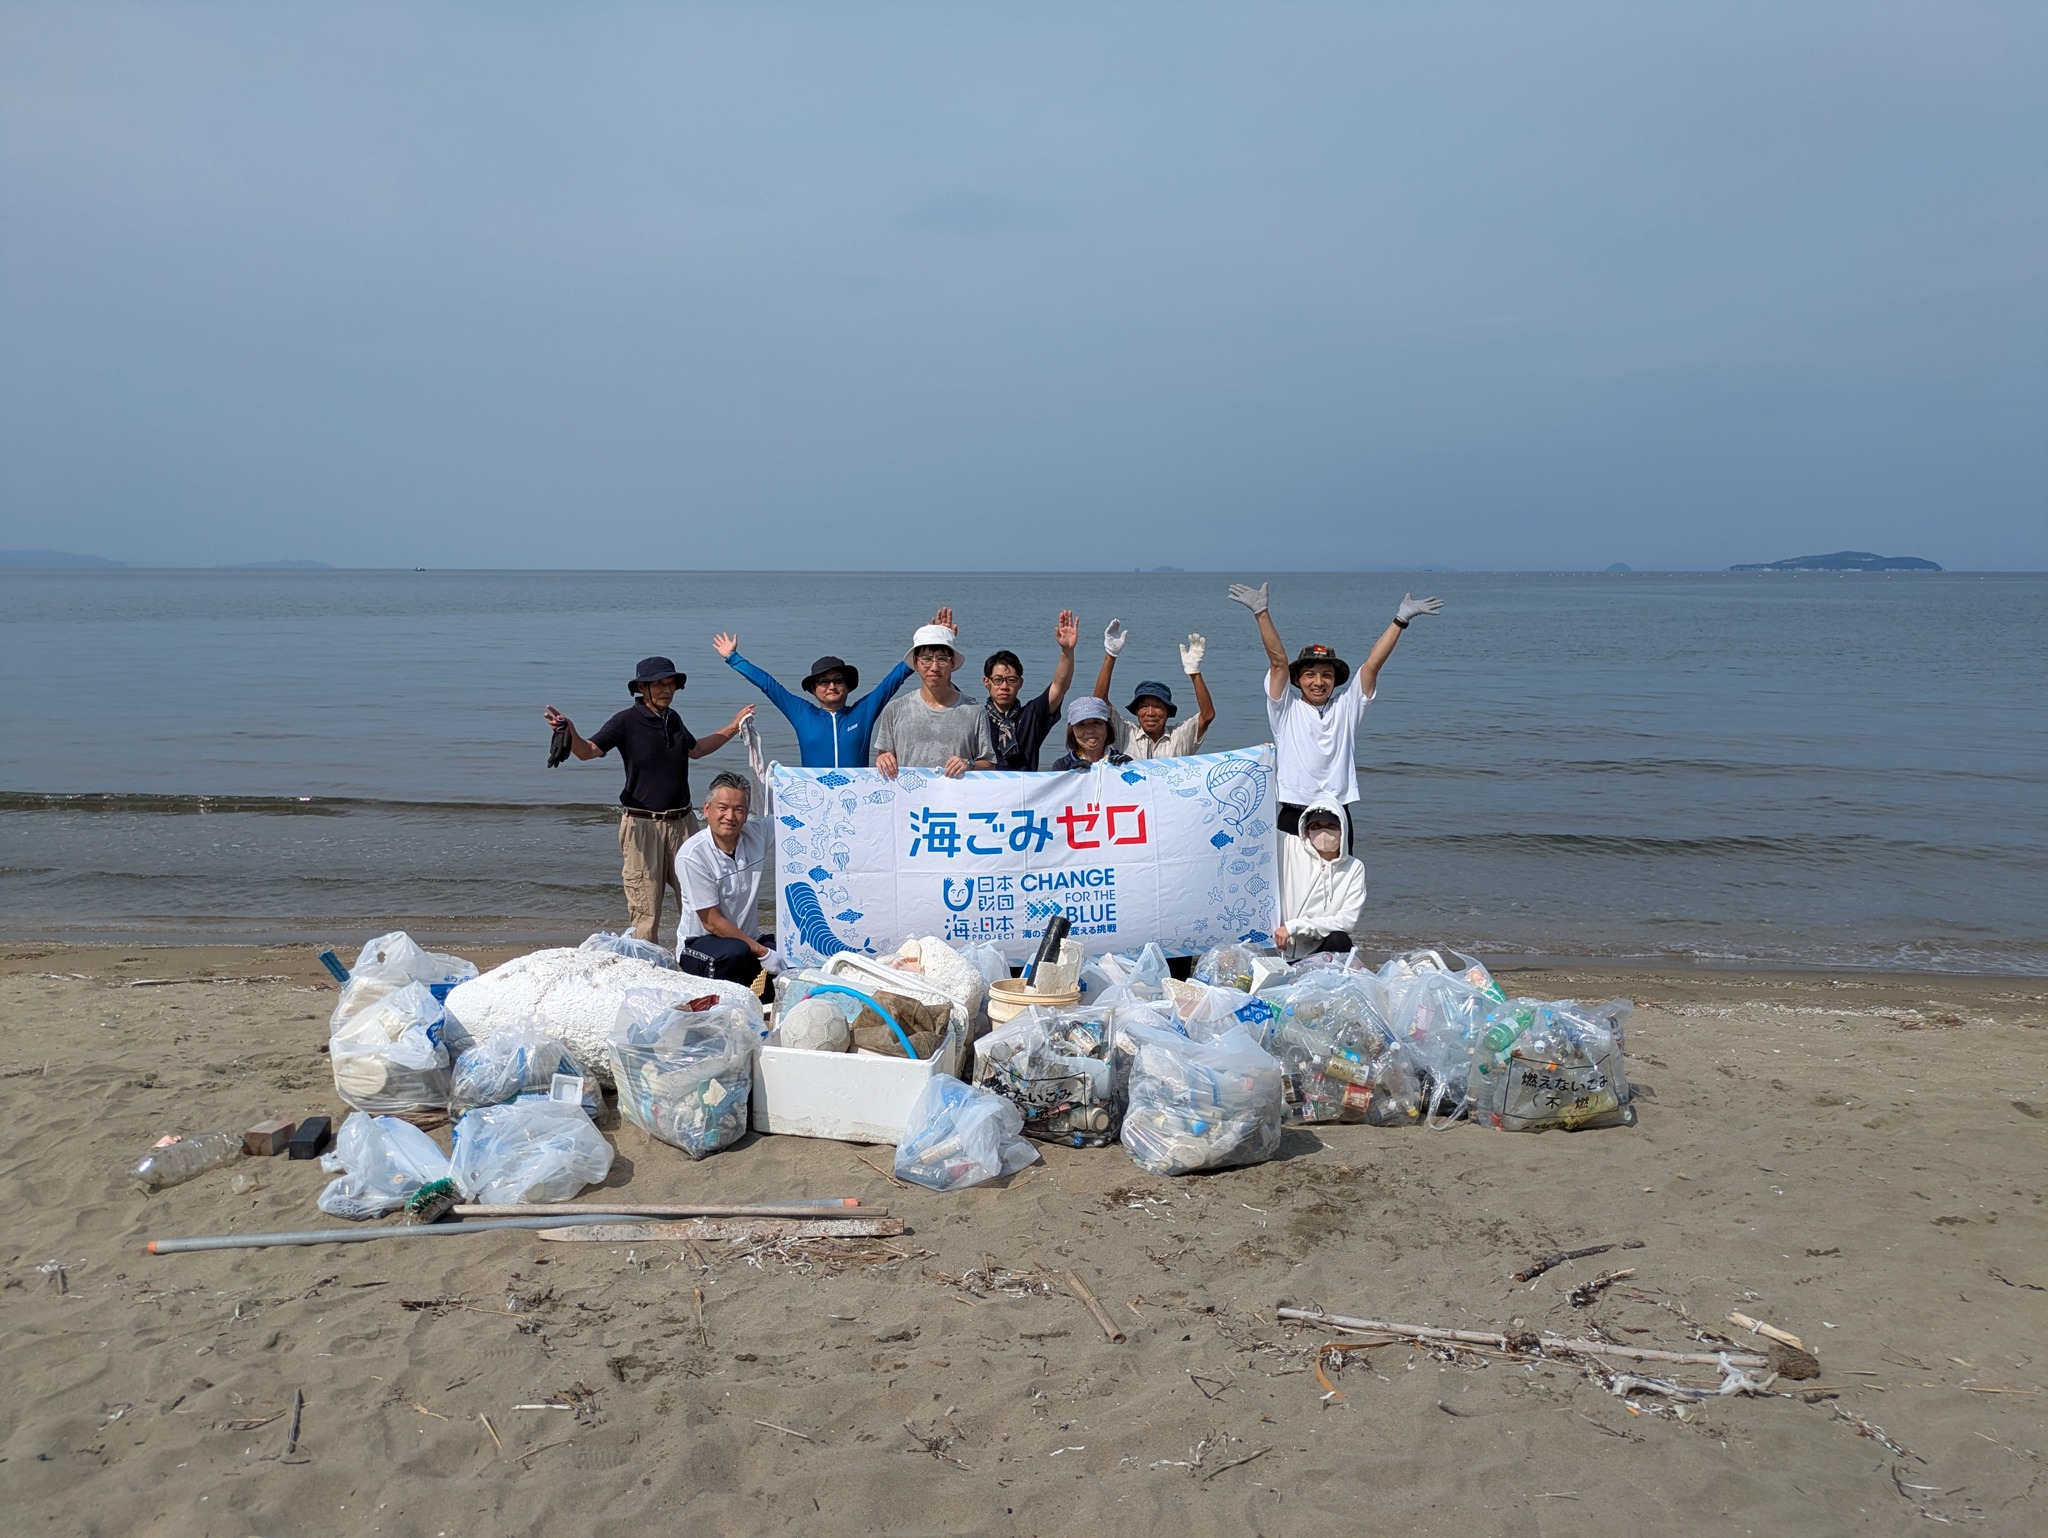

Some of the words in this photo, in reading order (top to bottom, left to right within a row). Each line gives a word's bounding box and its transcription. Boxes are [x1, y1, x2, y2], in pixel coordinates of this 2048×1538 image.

[909, 803, 1147, 859] 海ごみゼロ
[978, 875, 1013, 892] 日本
[1020, 868, 1116, 892] CHANGE
[1065, 891, 1090, 903] FOR
[1093, 889, 1116, 901] THE
[1066, 903, 1117, 924] BLUE
[972, 933, 1015, 941] PROJECT
[1022, 923, 1117, 939] 海の変える挑戦
[1521, 1072, 1608, 1092] 燃えないごみ
